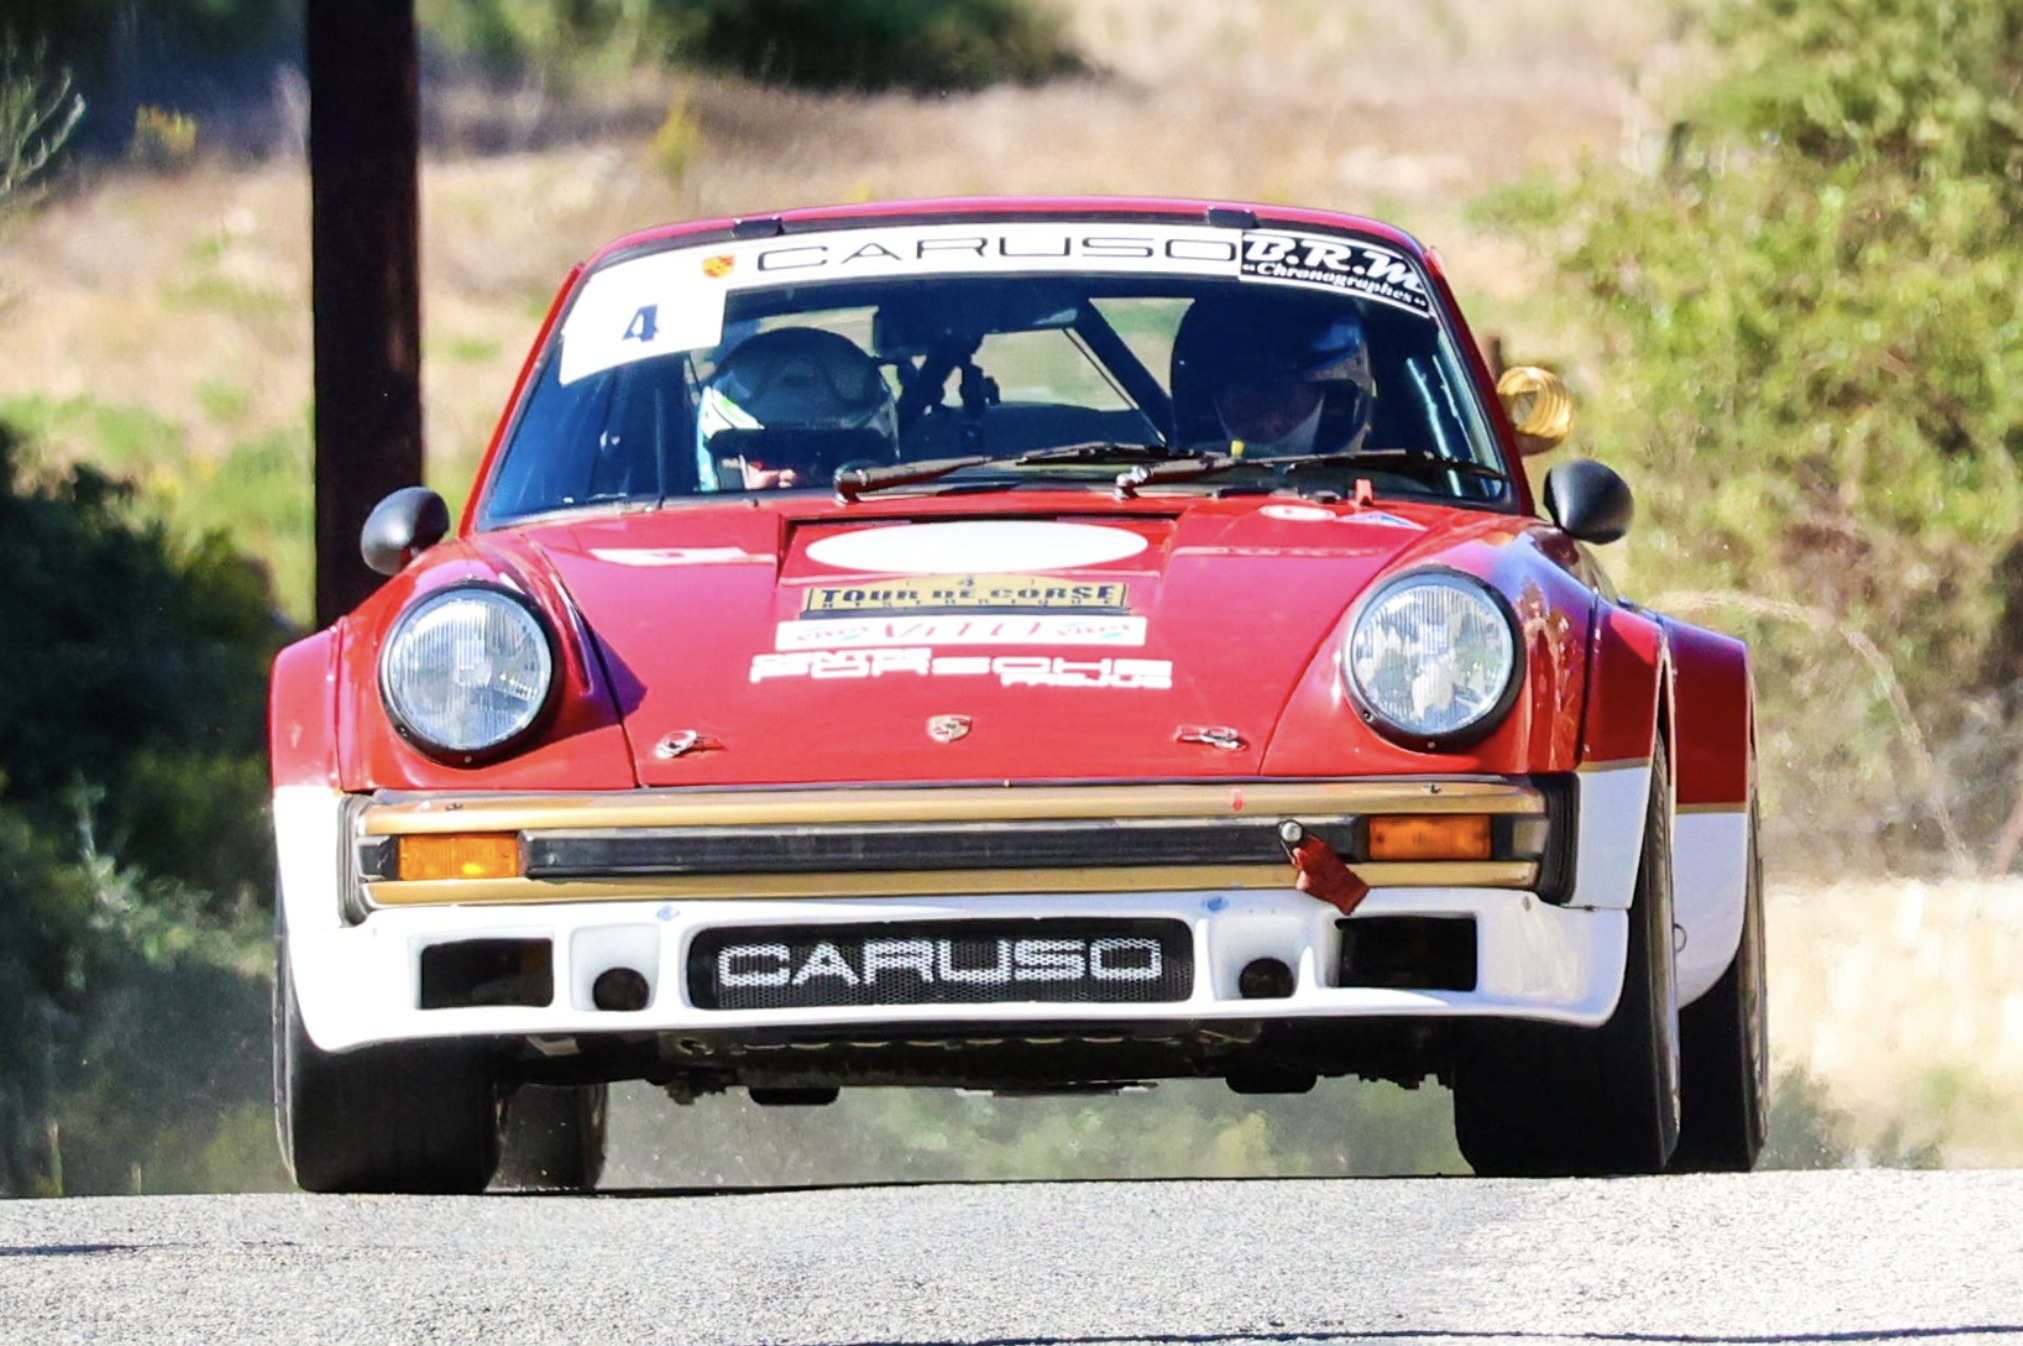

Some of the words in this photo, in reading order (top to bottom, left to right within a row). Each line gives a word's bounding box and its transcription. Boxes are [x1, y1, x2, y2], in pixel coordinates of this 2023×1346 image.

[756, 235, 1238, 272] CARUSO
[621, 303, 661, 343] 4
[820, 588, 919, 603] TOUR
[931, 589, 976, 601] DE
[989, 585, 1116, 601] CORSE
[749, 656, 1173, 684] PORSCHE
[717, 937, 1163, 988] CARUSO
